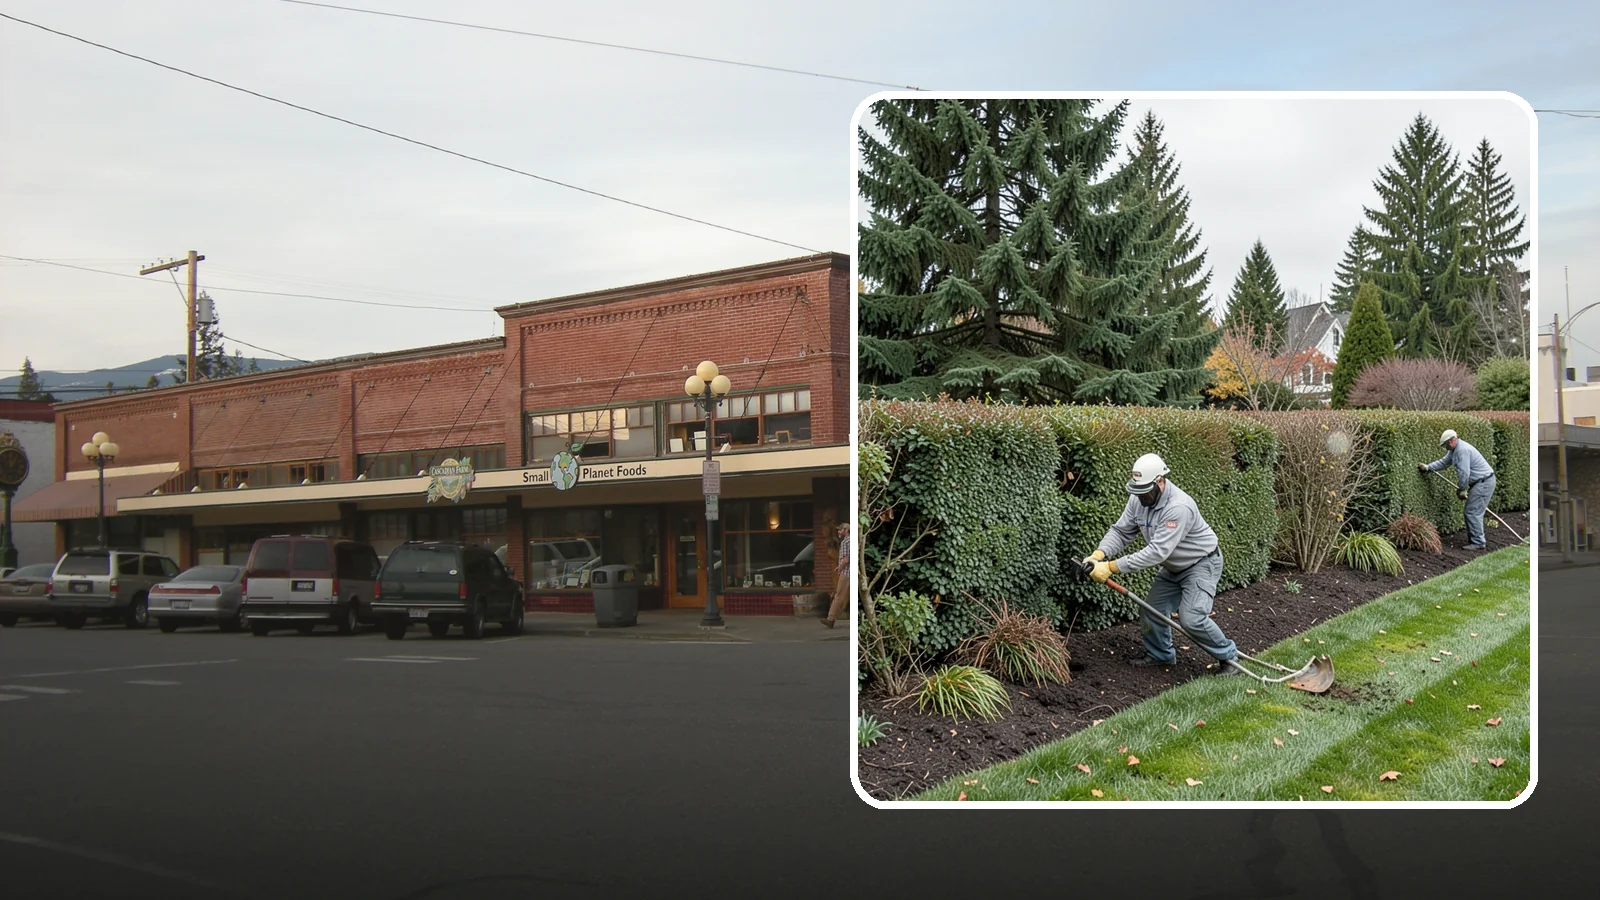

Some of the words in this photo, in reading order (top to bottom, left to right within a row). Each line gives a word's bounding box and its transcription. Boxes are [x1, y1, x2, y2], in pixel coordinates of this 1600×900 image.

[431, 467, 455, 475] CASCADIAN
[523, 471, 549, 482] Small
[583, 468, 613, 479] Planet
[617, 464, 647, 476] Foods
